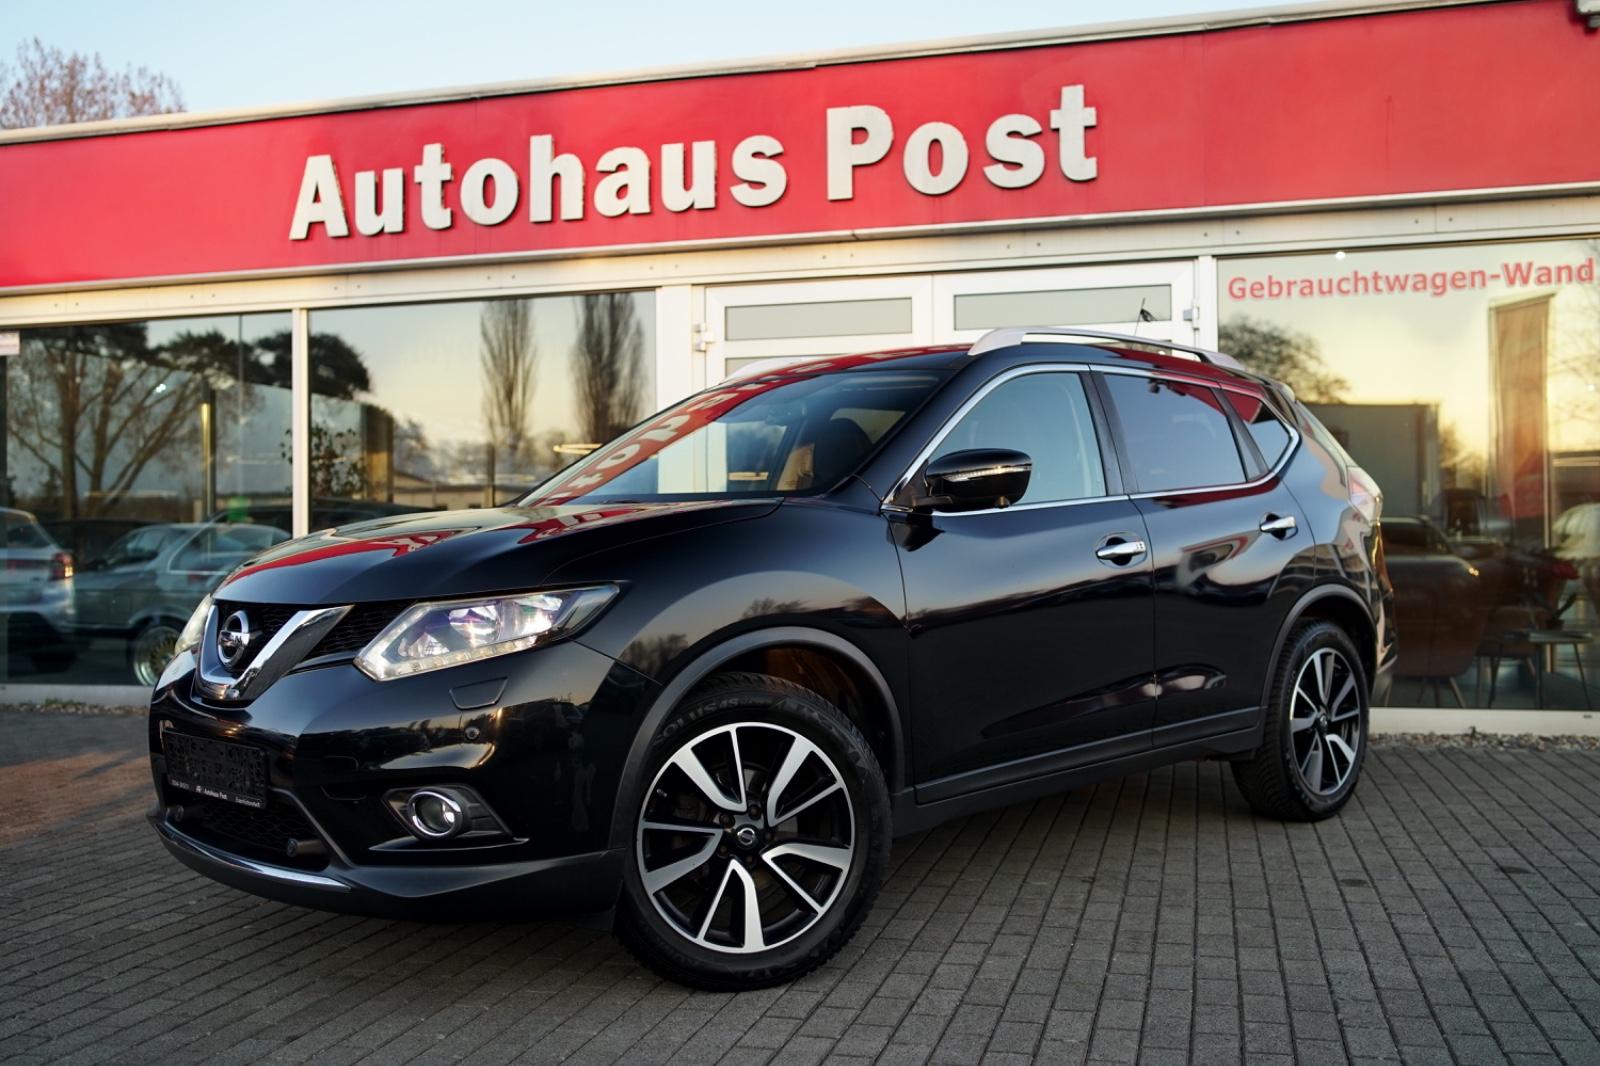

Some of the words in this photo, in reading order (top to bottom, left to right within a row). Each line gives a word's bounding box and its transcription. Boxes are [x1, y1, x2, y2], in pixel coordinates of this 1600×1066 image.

[288, 133, 789, 242] Autohaus
[826, 84, 1099, 202] Post
[1227, 256, 1596, 300] Gebrauchtwagen-Wand
